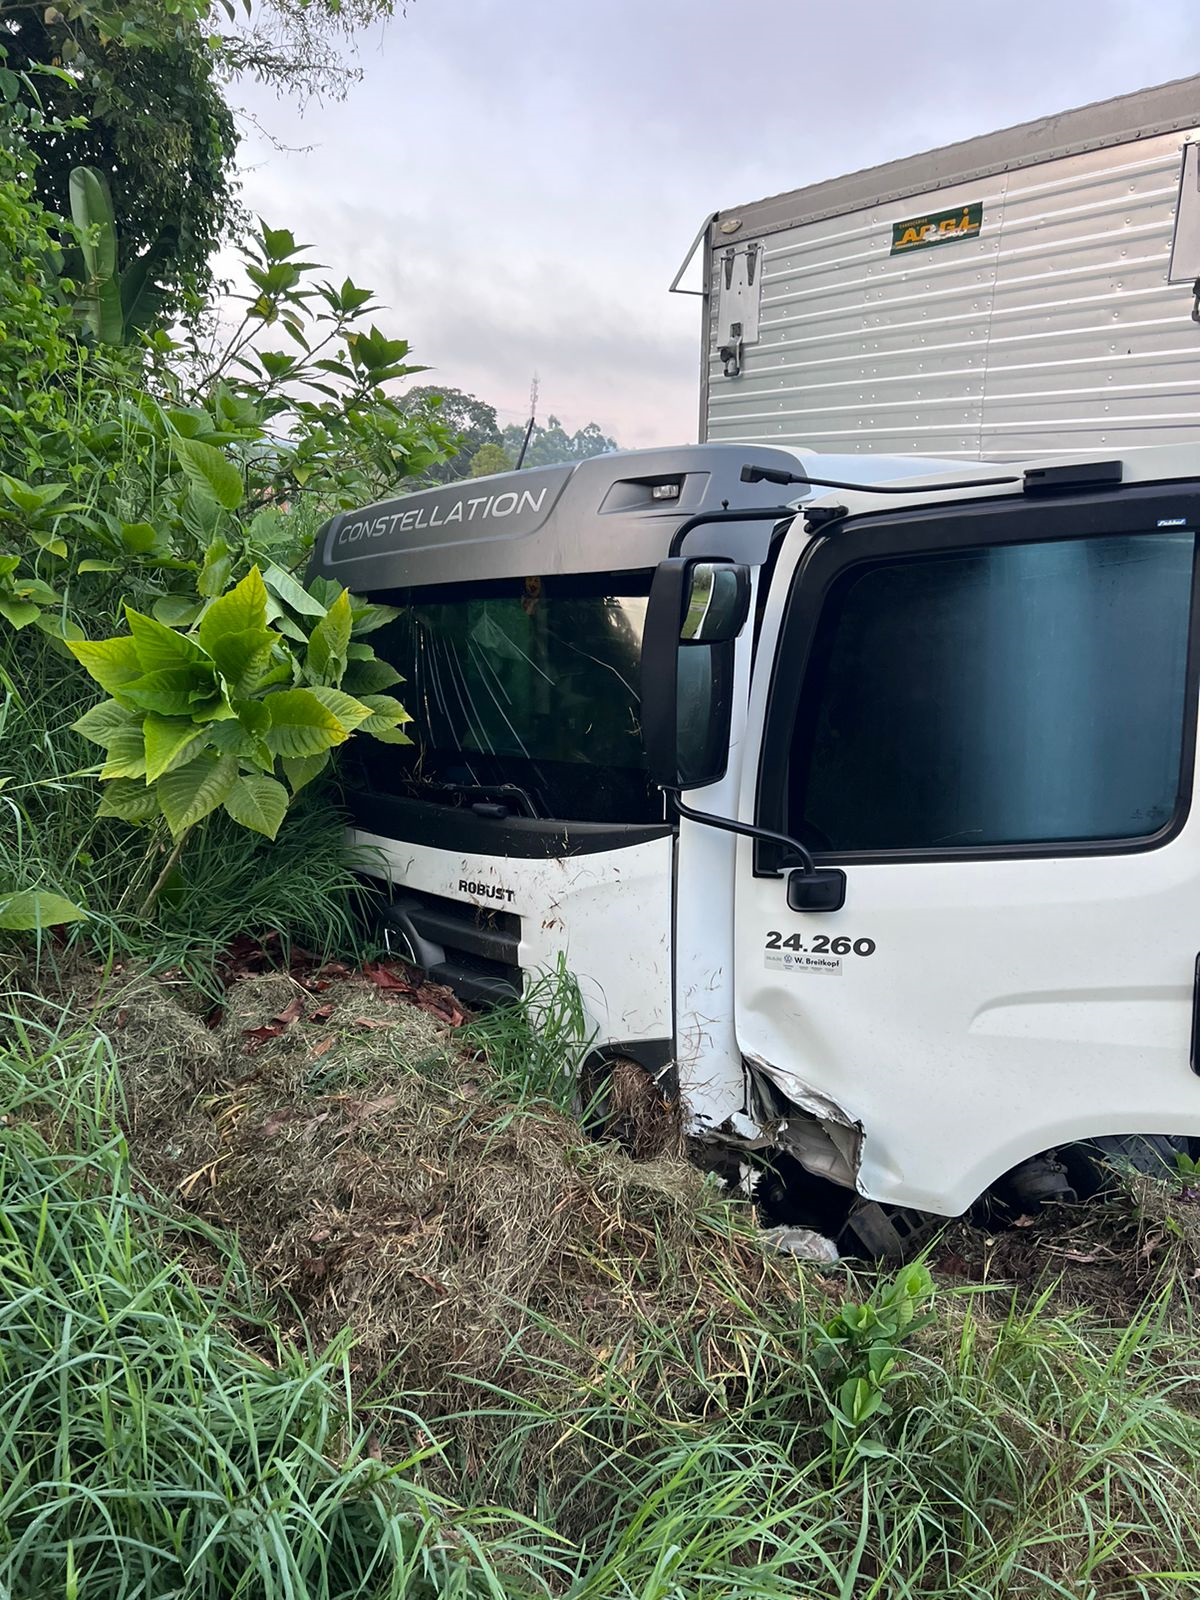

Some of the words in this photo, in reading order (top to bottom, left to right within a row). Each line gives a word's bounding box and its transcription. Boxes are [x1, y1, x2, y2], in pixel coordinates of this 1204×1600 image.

[338, 487, 548, 545] CONSTELLATION
[458, 879, 515, 902] ROBUST
[765, 930, 876, 957] 24.260
[794, 956, 804, 964] W.
[805, 957, 840, 968] Breitkopf
